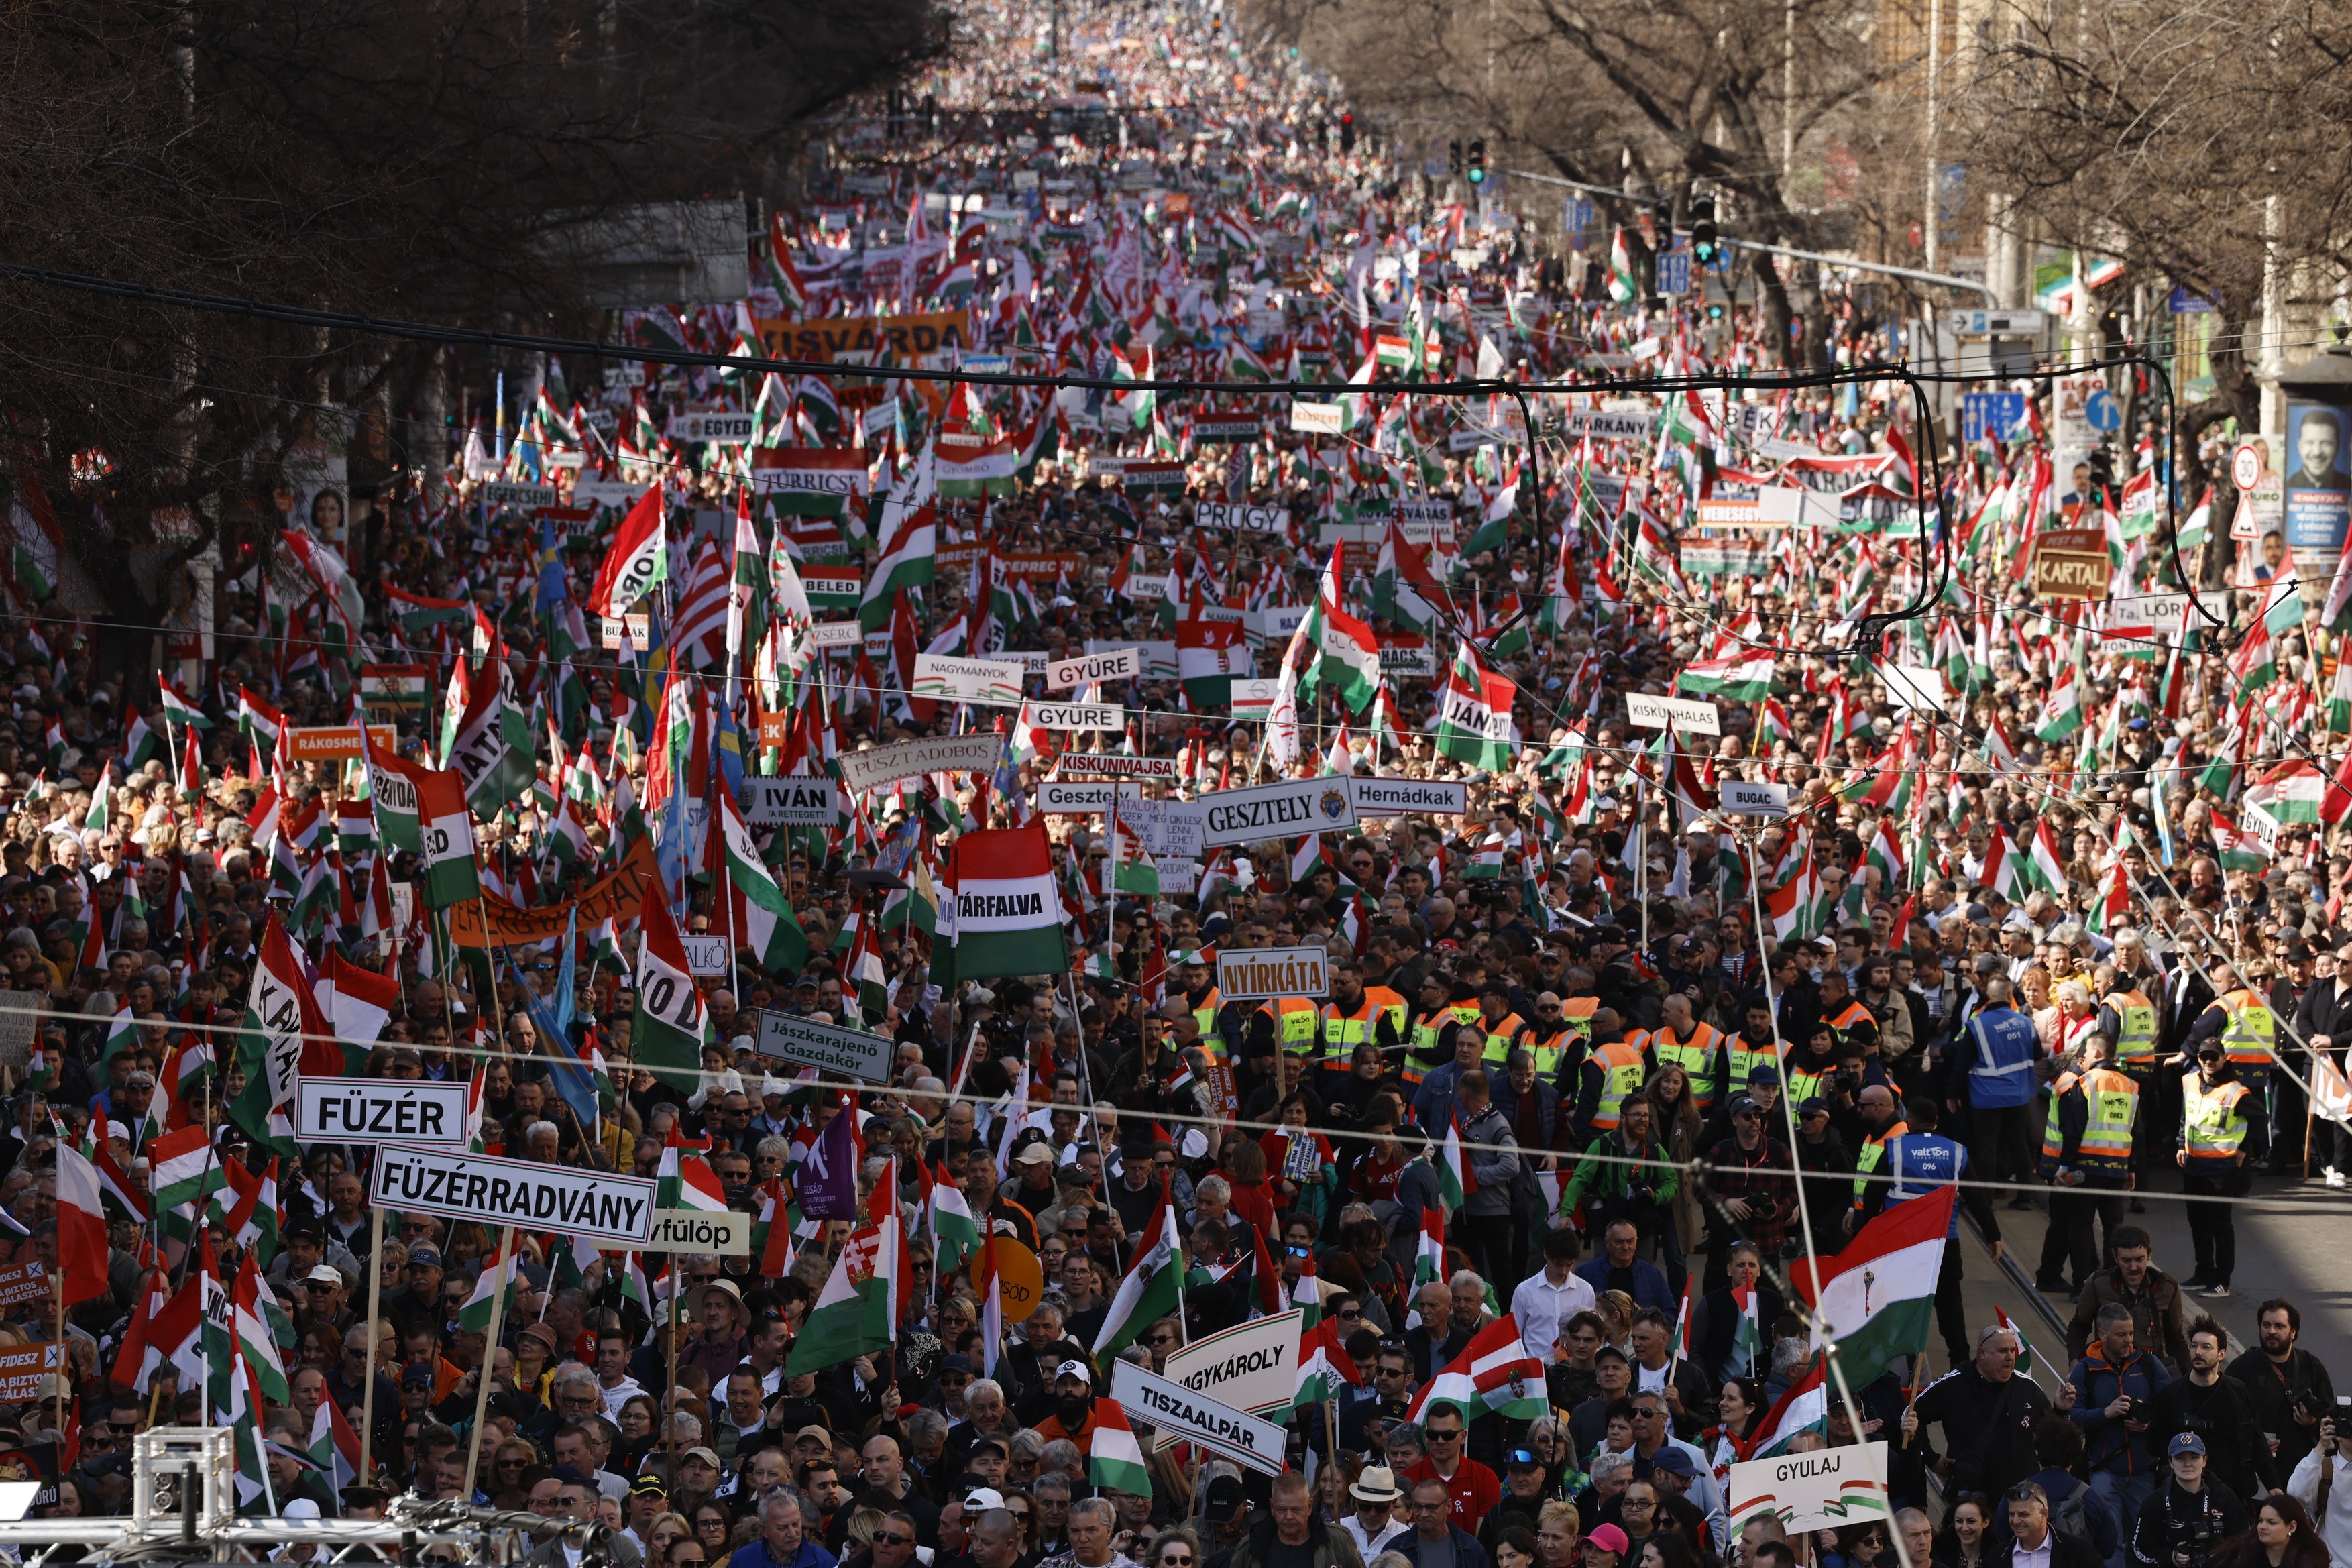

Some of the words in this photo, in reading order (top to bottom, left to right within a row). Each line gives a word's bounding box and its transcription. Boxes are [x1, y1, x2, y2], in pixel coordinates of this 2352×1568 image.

[2040, 561, 2104, 586] KARTAL
[806, 581, 854, 592] BELED
[1059, 657, 1129, 683] GYÜRE
[1633, 704, 1714, 724] KISKUNHALAS
[1063, 755, 1172, 776] KISKUNMAJSA
[765, 785, 826, 808] IVÁN
[1359, 784, 1453, 805] Hernádkak
[1736, 792, 1771, 804] BUGAC
[1208, 795, 1312, 833] GESZTELY
[1168, 836, 1194, 844] LEHET
[2245, 811, 2273, 847] GYULA
[1157, 864, 1190, 875] SADDAM
[683, 939, 726, 968] ALKÓ
[1224, 954, 1323, 995] NYÍRKÁTA
[771, 1021, 879, 1058] Jászkarajenő
[783, 1042, 863, 1071] Gazdakör
[1214, 1073, 1223, 1102] BIZTOS
[1222, 1066, 1233, 1092] FIDESZ
[318, 1089, 444, 1135] FÜZÉR
[1923, 1162, 1936, 1170] 096
[381, 1157, 645, 1233] FÜZÉRRADVÁNY
[651, 1219, 731, 1249] vfülöp
[0, 1270, 22, 1284] IDESZ
[4, 1281, 37, 1296] BIZTOS
[1, 1286, 50, 1307] VÁLASZTÁS
[0, 1352, 38, 1367] FIDESZ
[1141, 1386, 1254, 1449] TISZAALPÁR
[1776, 1455, 1840, 1481] GYULAJ
